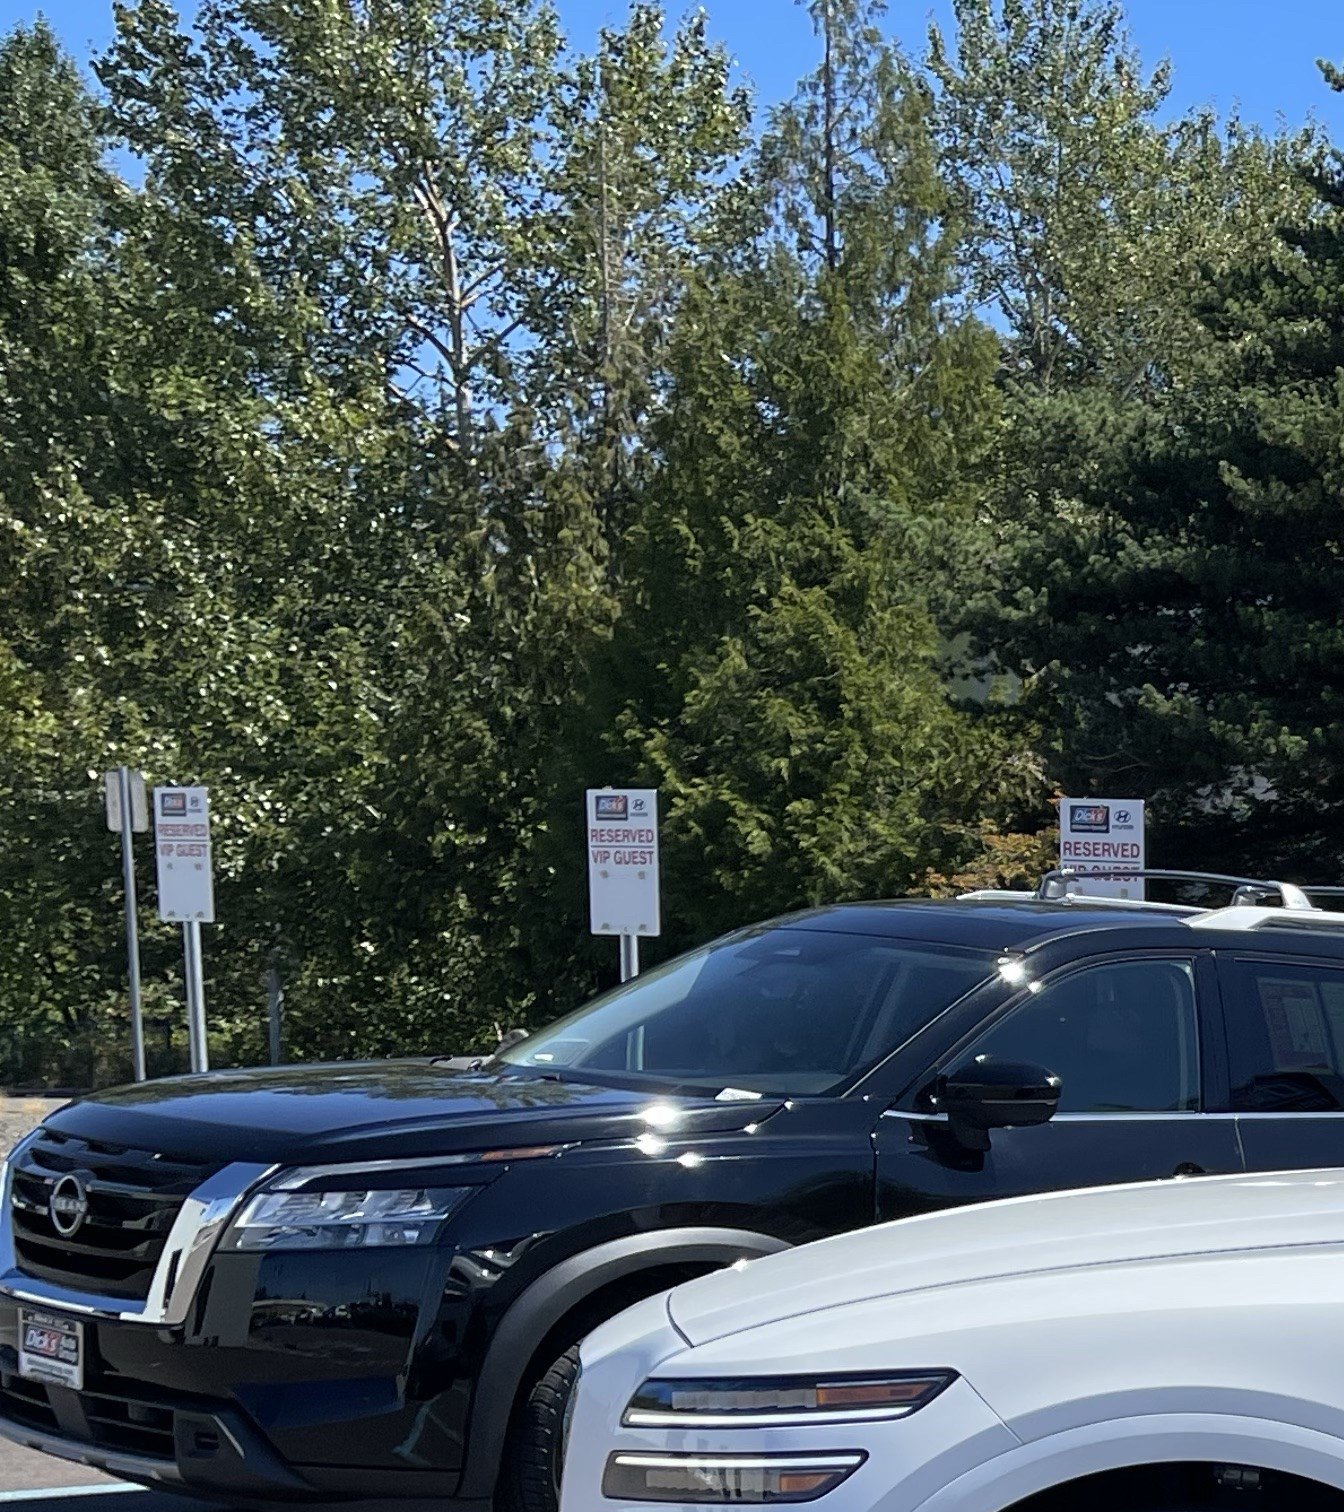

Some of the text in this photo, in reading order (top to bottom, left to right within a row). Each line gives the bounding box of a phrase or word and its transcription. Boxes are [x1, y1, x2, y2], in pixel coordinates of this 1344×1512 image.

[590, 828, 654, 843] RESERVED
[591, 850, 654, 865] VIP GUEST
[1063, 841, 1140, 859] RESERVED
